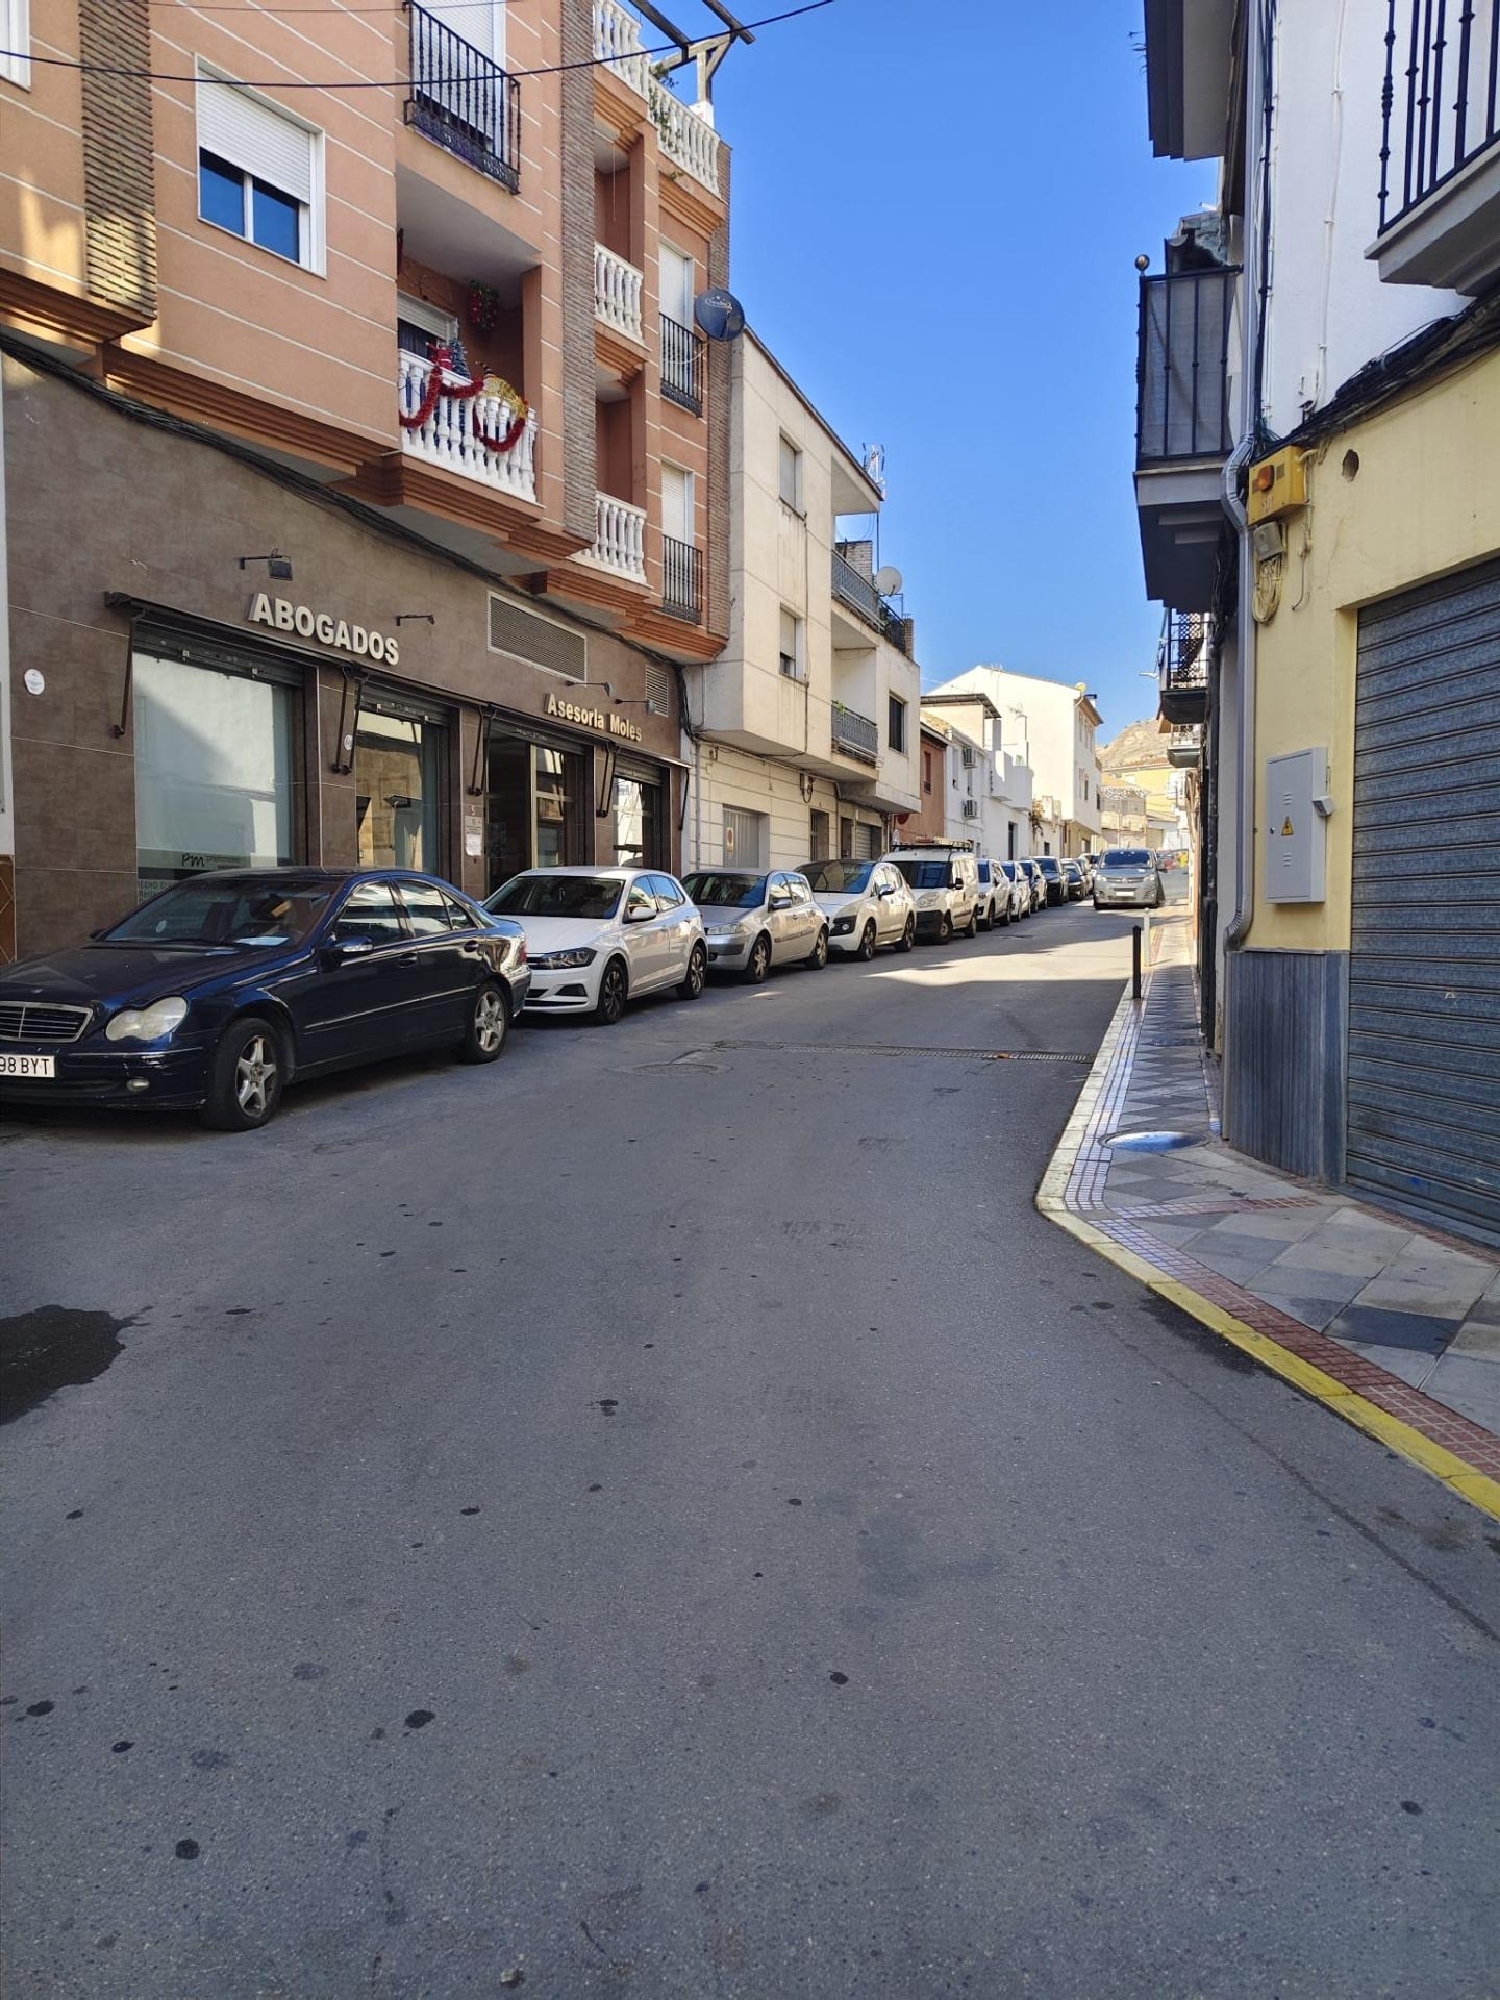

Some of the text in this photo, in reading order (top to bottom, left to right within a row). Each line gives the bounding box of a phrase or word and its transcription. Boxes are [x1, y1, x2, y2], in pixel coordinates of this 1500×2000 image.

[248, 592, 399, 666] ABOGADOS
[608, 713, 642, 743] Moles
[21, 1058, 49, 1075] BYT
